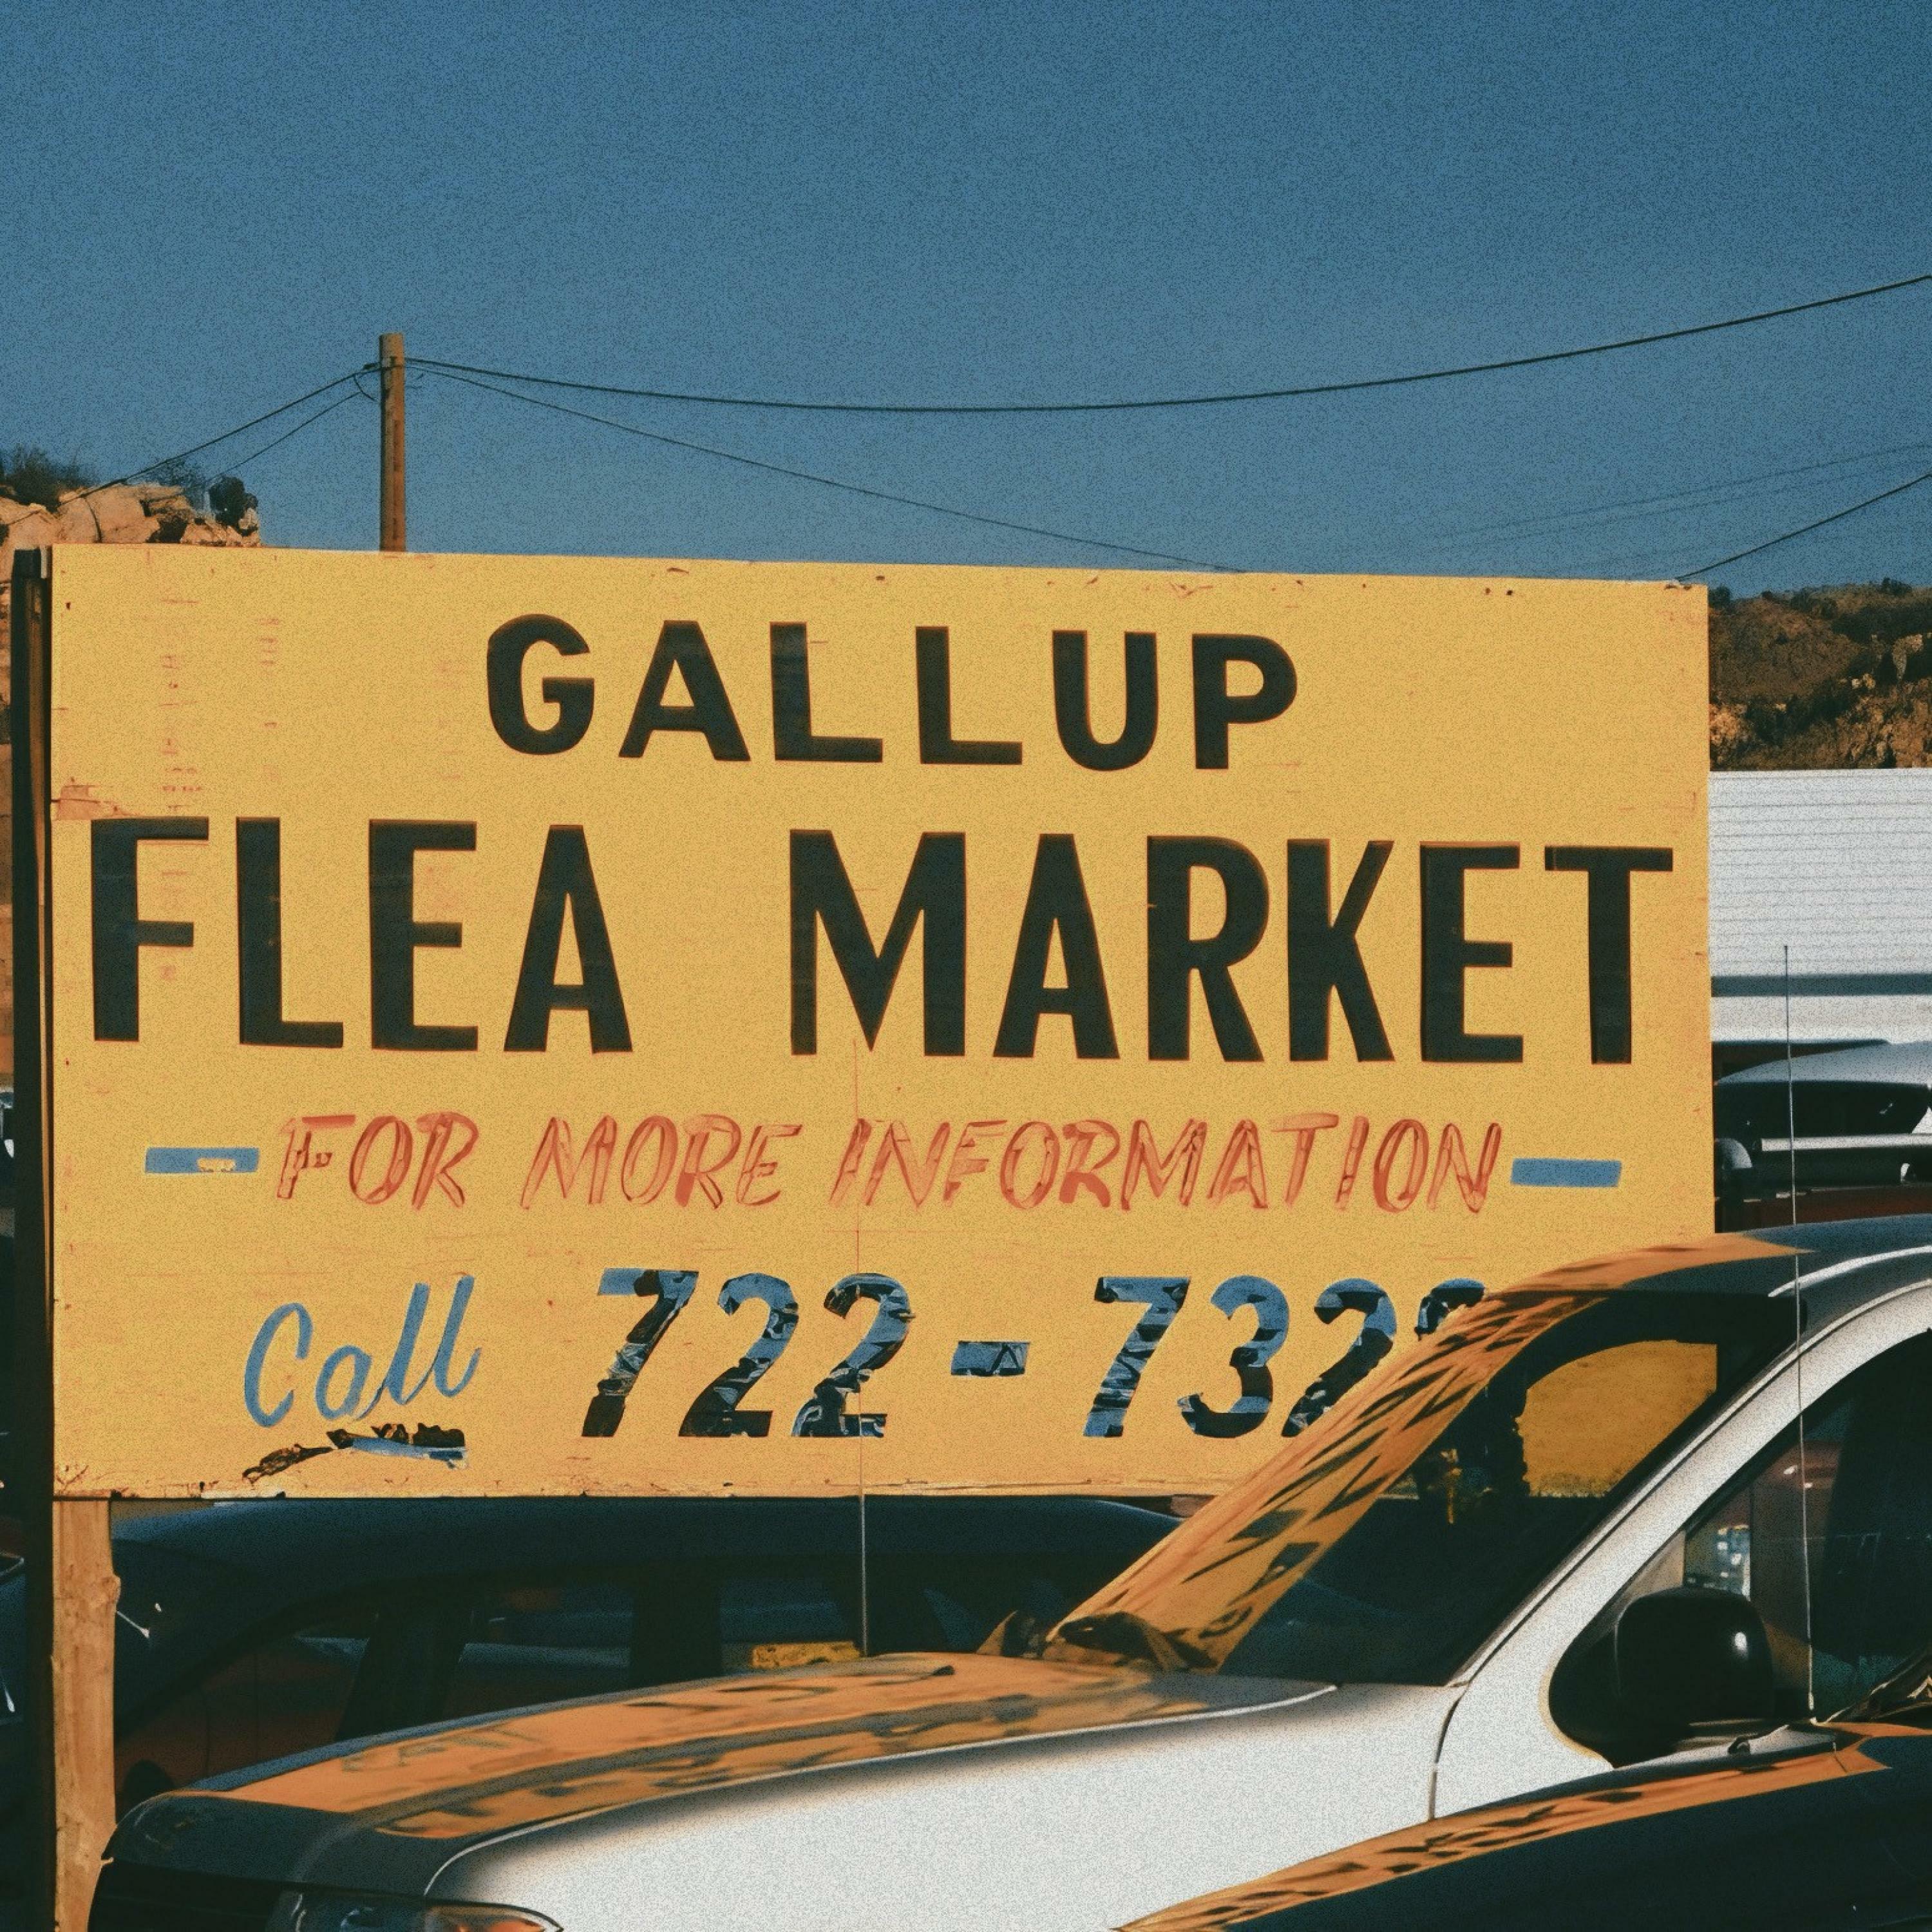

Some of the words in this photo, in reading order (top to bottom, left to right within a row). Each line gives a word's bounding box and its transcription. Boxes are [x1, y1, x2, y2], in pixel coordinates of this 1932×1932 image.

[487, 613, 1296, 772] GALLUP
[91, 816, 631, 1054] FLEA
[790, 829, 1672, 1065] MARKET
[277, 1113, 478, 1210] FOR
[520, 1115, 802, 1210] MORE
[831, 1114, 1504, 1215] INFORMATION
[244, 1275, 480, 1427] Call
